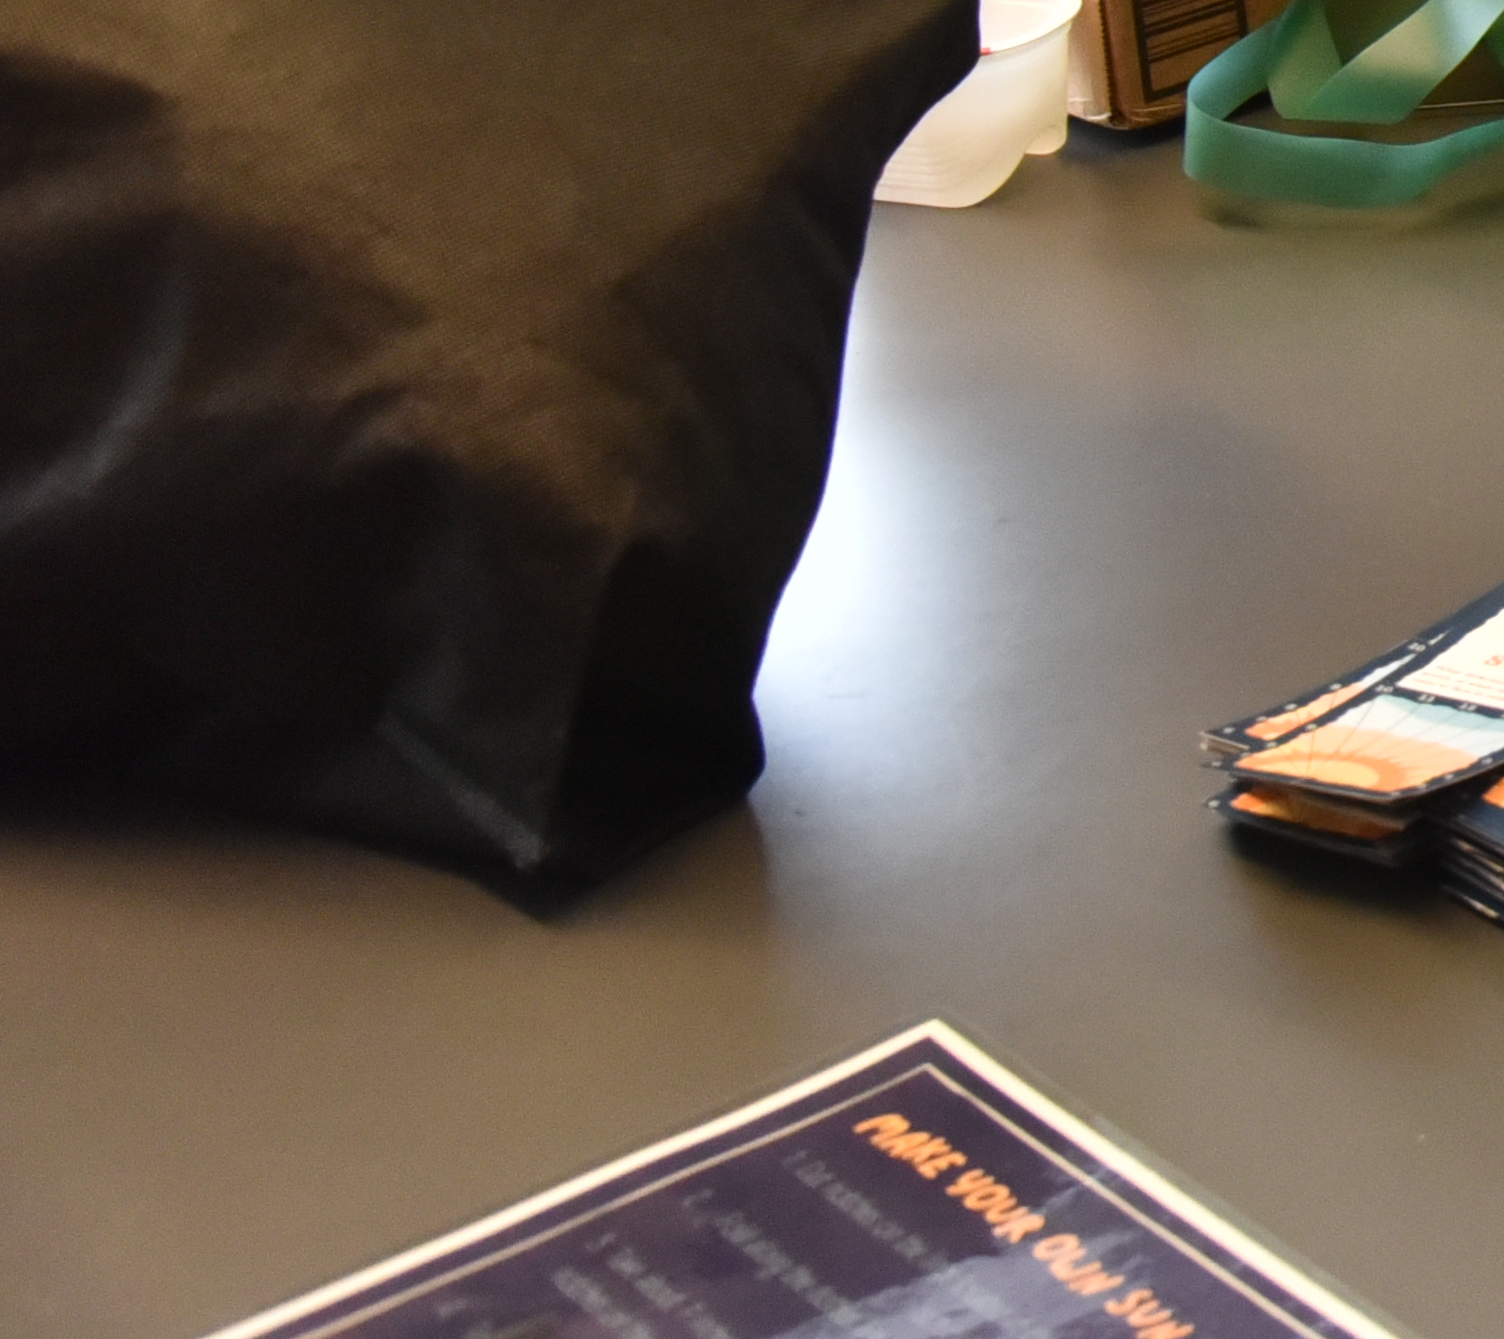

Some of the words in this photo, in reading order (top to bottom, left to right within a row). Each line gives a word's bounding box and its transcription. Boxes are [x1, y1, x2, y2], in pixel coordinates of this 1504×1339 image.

[852, 1109, 966, 1185] MAKE
[945, 1161, 1049, 1247] YOUR
[1030, 1230, 1124, 1302] OWN
